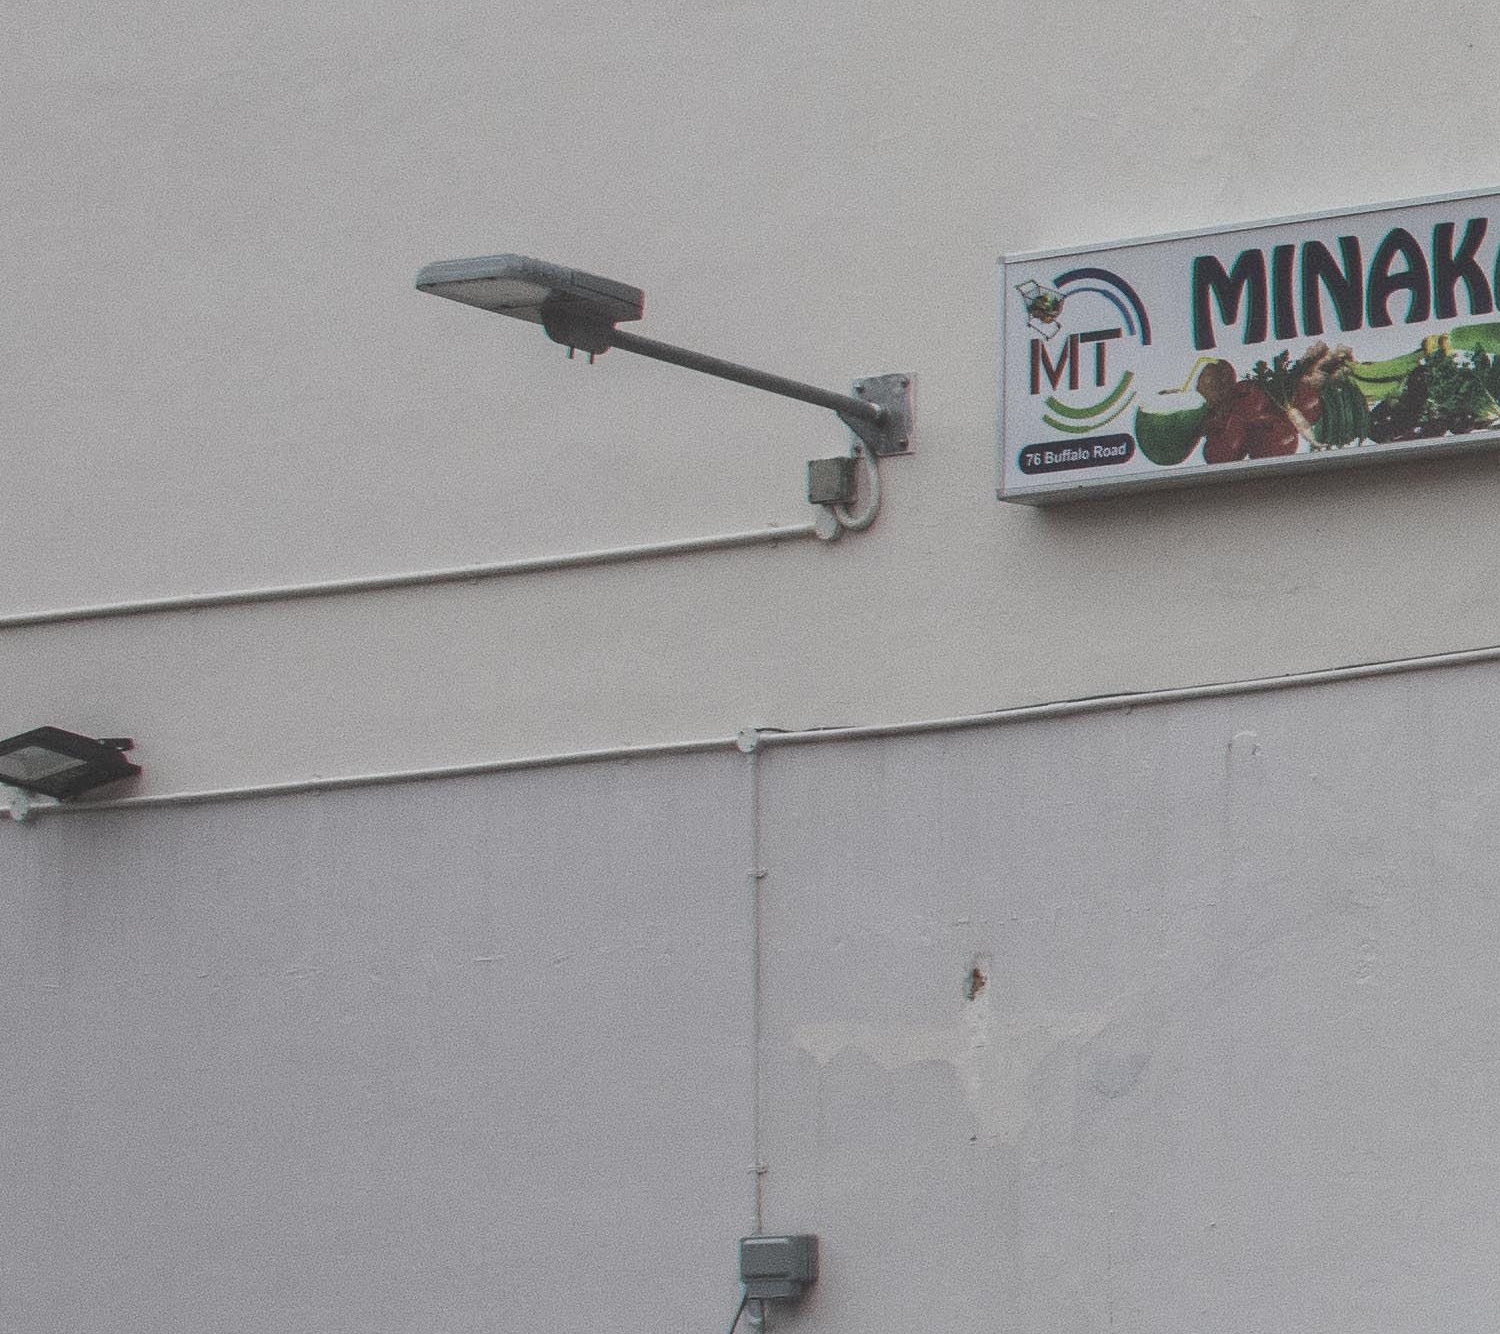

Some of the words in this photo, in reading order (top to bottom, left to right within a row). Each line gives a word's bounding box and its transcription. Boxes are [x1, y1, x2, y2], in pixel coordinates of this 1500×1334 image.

[1030, 327, 1123, 395] MT
[1026, 453, 1041, 467] 76
[1044, 448, 1090, 465] Buffalo
[1093, 442, 1127, 458] Road
